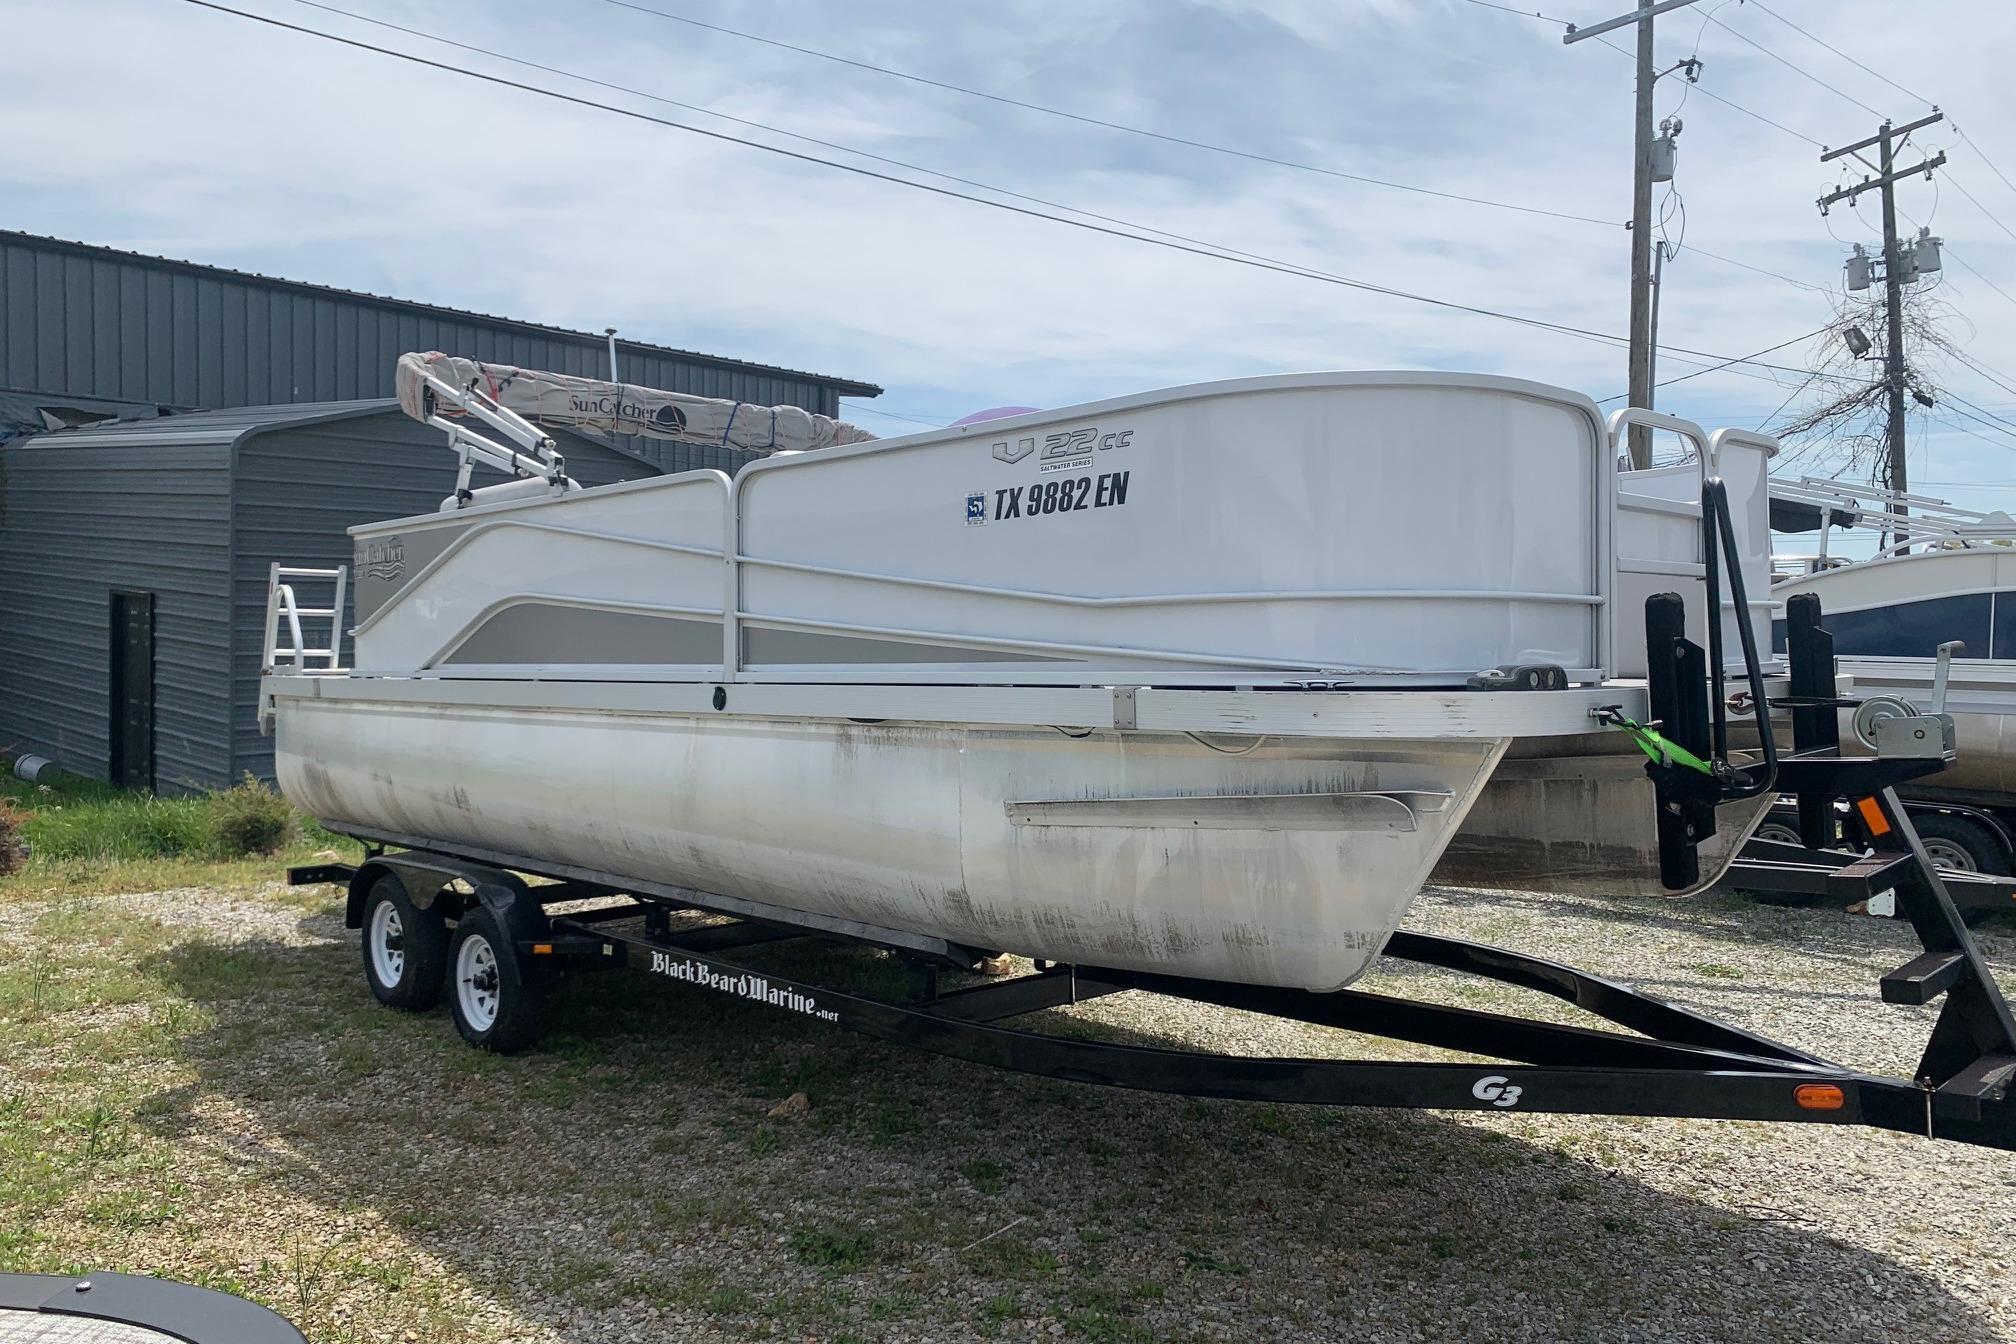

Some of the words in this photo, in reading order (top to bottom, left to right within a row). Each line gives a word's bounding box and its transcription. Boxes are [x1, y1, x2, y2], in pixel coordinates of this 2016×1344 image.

[1040, 463, 1071, 472] SALTWATER
[1071, 459, 1091, 468] SERIES
[994, 486, 1024, 520] TX
[1026, 476, 1092, 516] 9882
[1094, 470, 1130, 508] EN
[1472, 1075, 1523, 1107] G3
